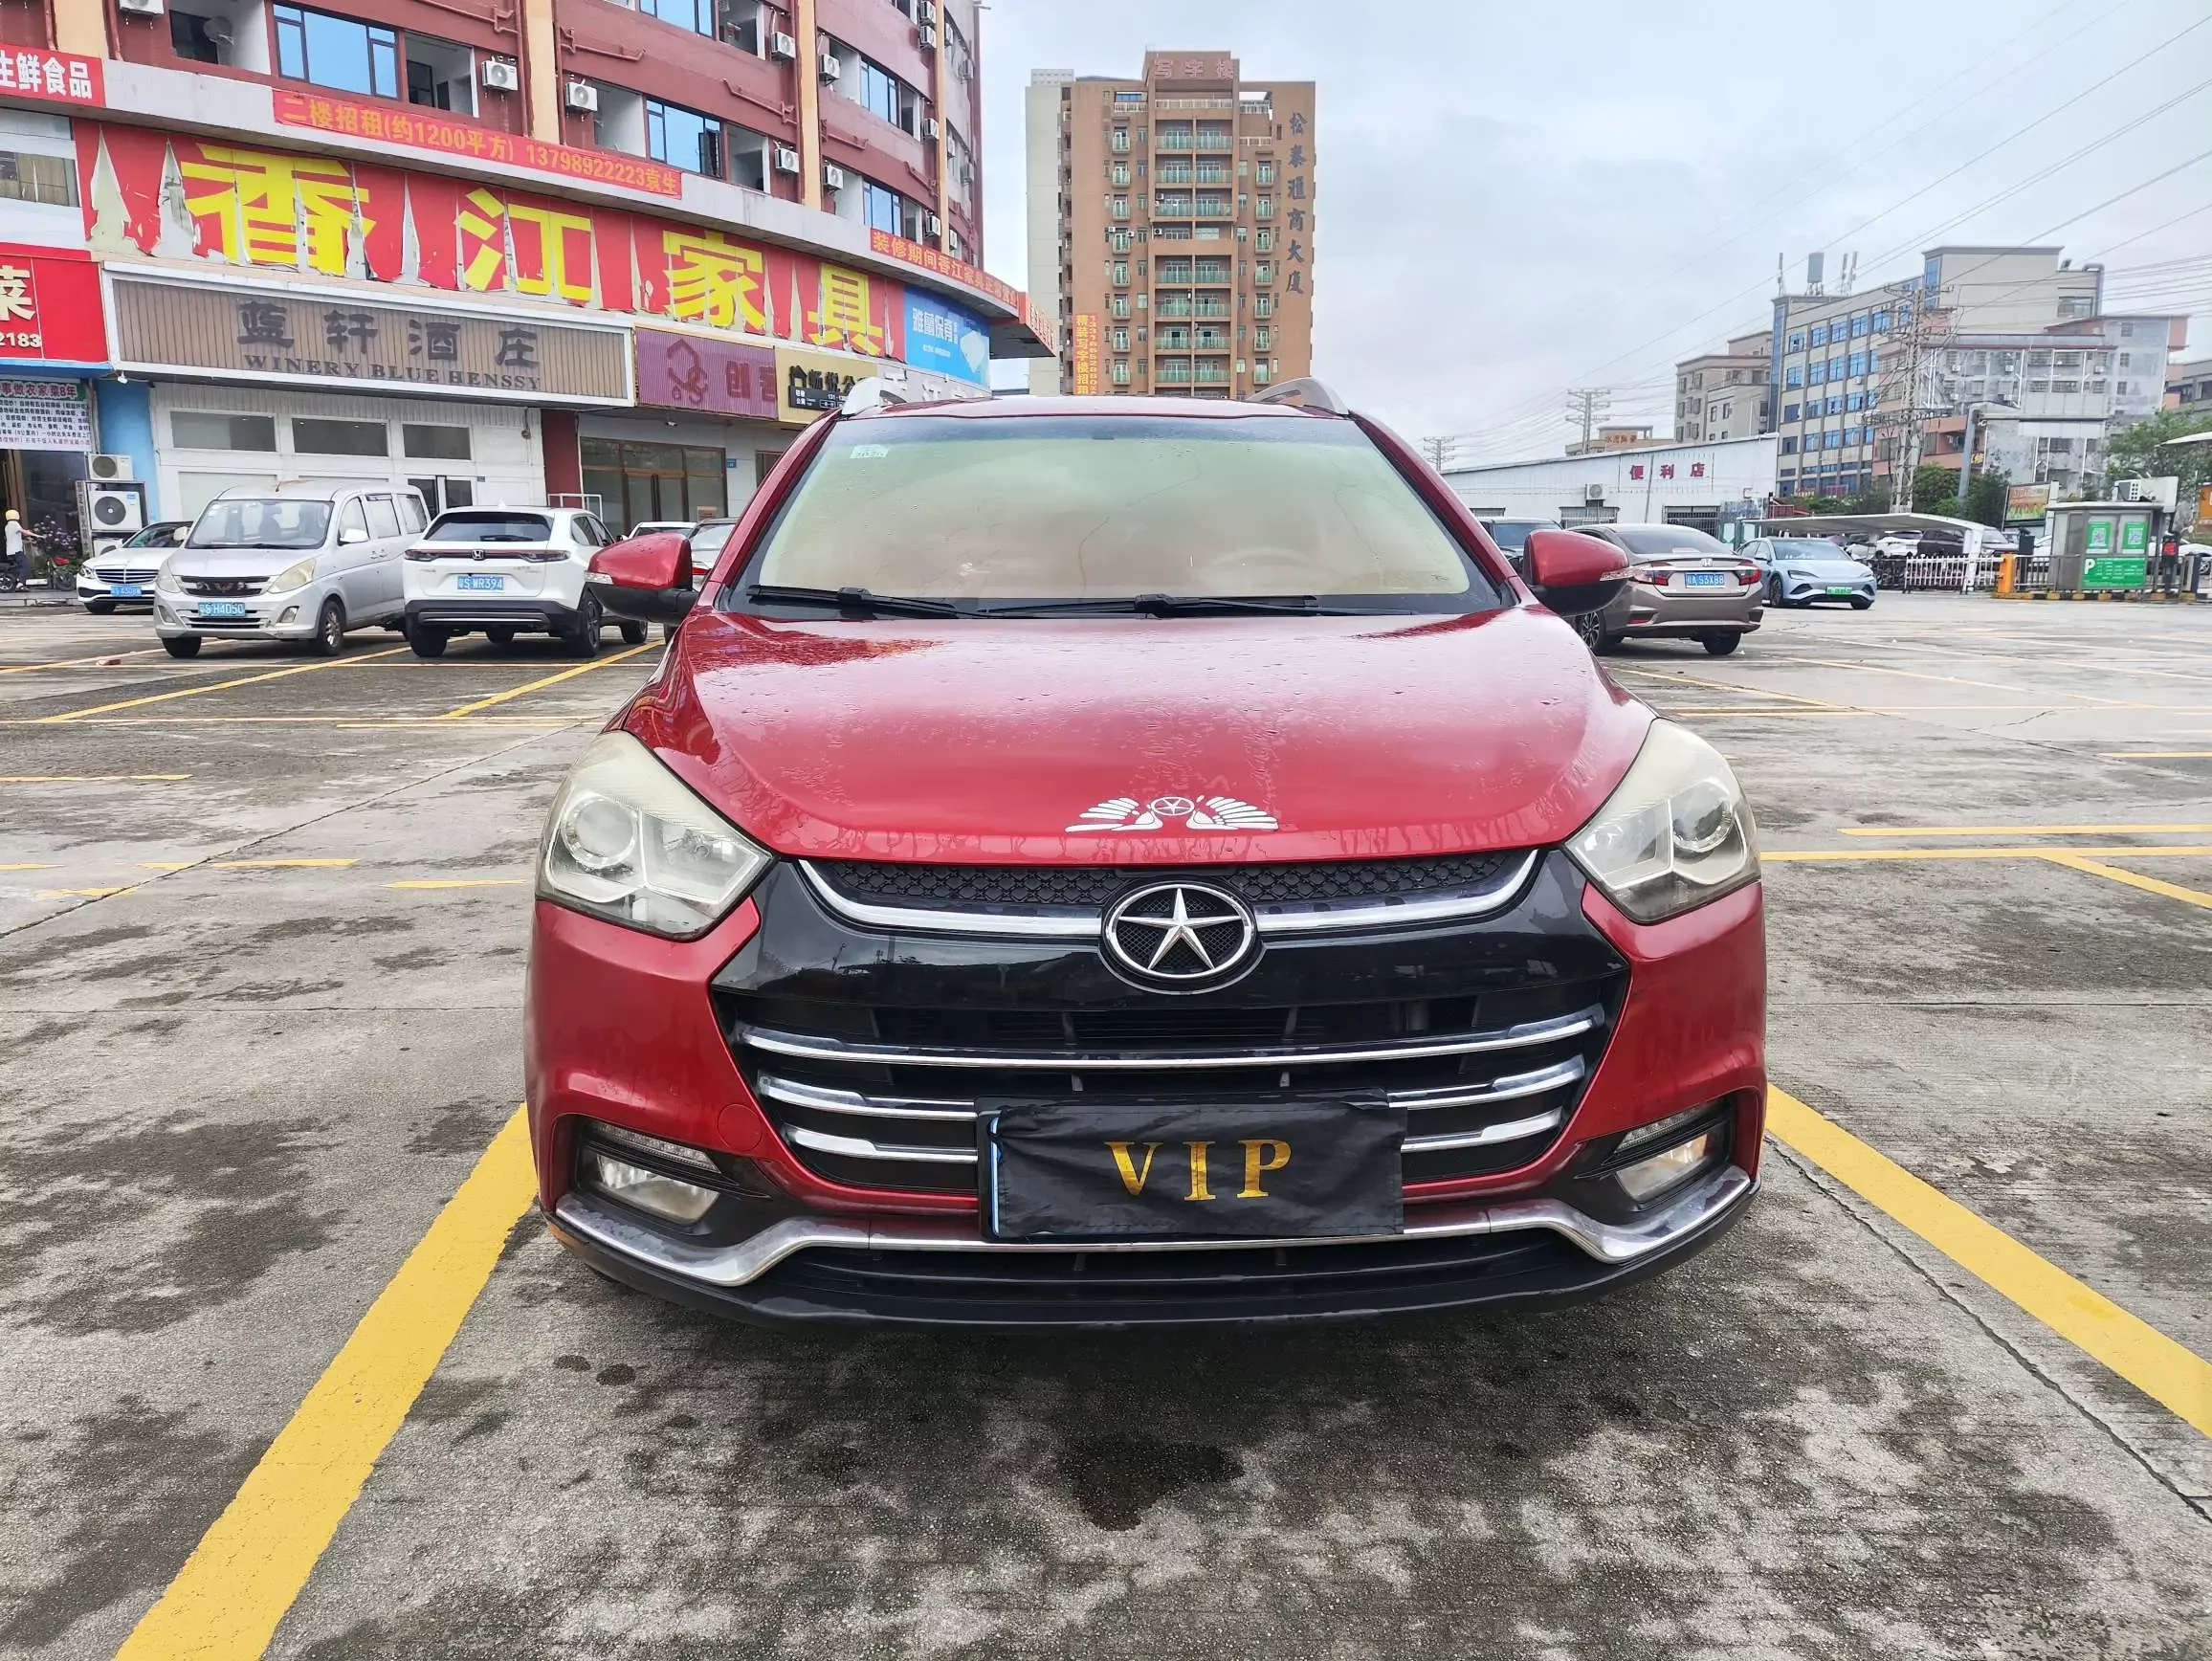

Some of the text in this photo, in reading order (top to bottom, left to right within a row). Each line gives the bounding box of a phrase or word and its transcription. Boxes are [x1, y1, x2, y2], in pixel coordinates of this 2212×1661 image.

[0, 50, 92, 99] 生鲜食品
[181, 142, 884, 357] 香江家具
[244, 354, 541, 390] WINERY BLUE HENSSY
[1629, 462, 1705, 480] 便利店
[2084, 559, 2095, 574] P
[1103, 1139, 1293, 1201] VIP
